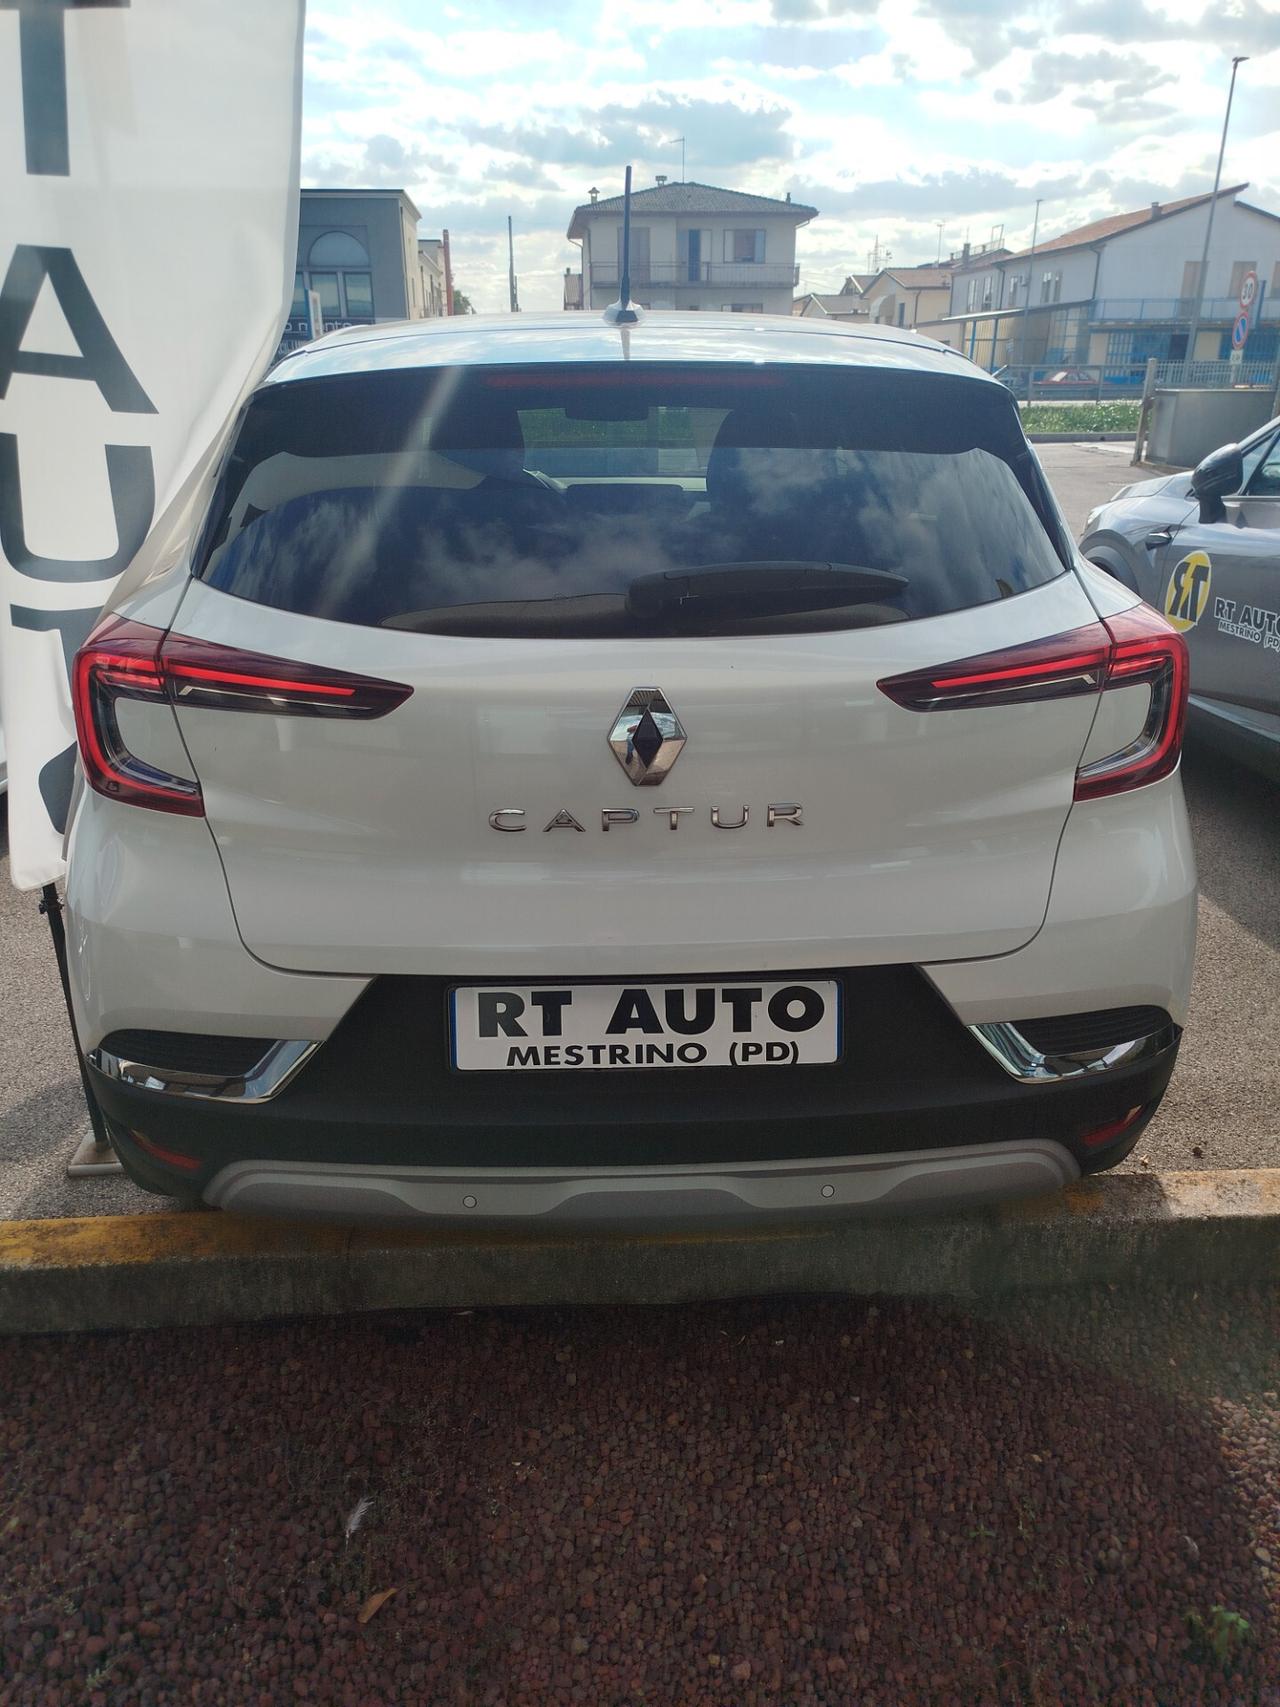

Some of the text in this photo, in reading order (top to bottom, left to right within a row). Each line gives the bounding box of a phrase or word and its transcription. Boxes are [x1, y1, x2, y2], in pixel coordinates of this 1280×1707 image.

[1214, 597, 1236, 622] RT
[1218, 620, 1261, 643] MESTRINO
[488, 803, 805, 833] CAPTUR
[477, 985, 826, 1038] RT AUTO
[506, 1041, 799, 1067] MESTRINO (PD)
